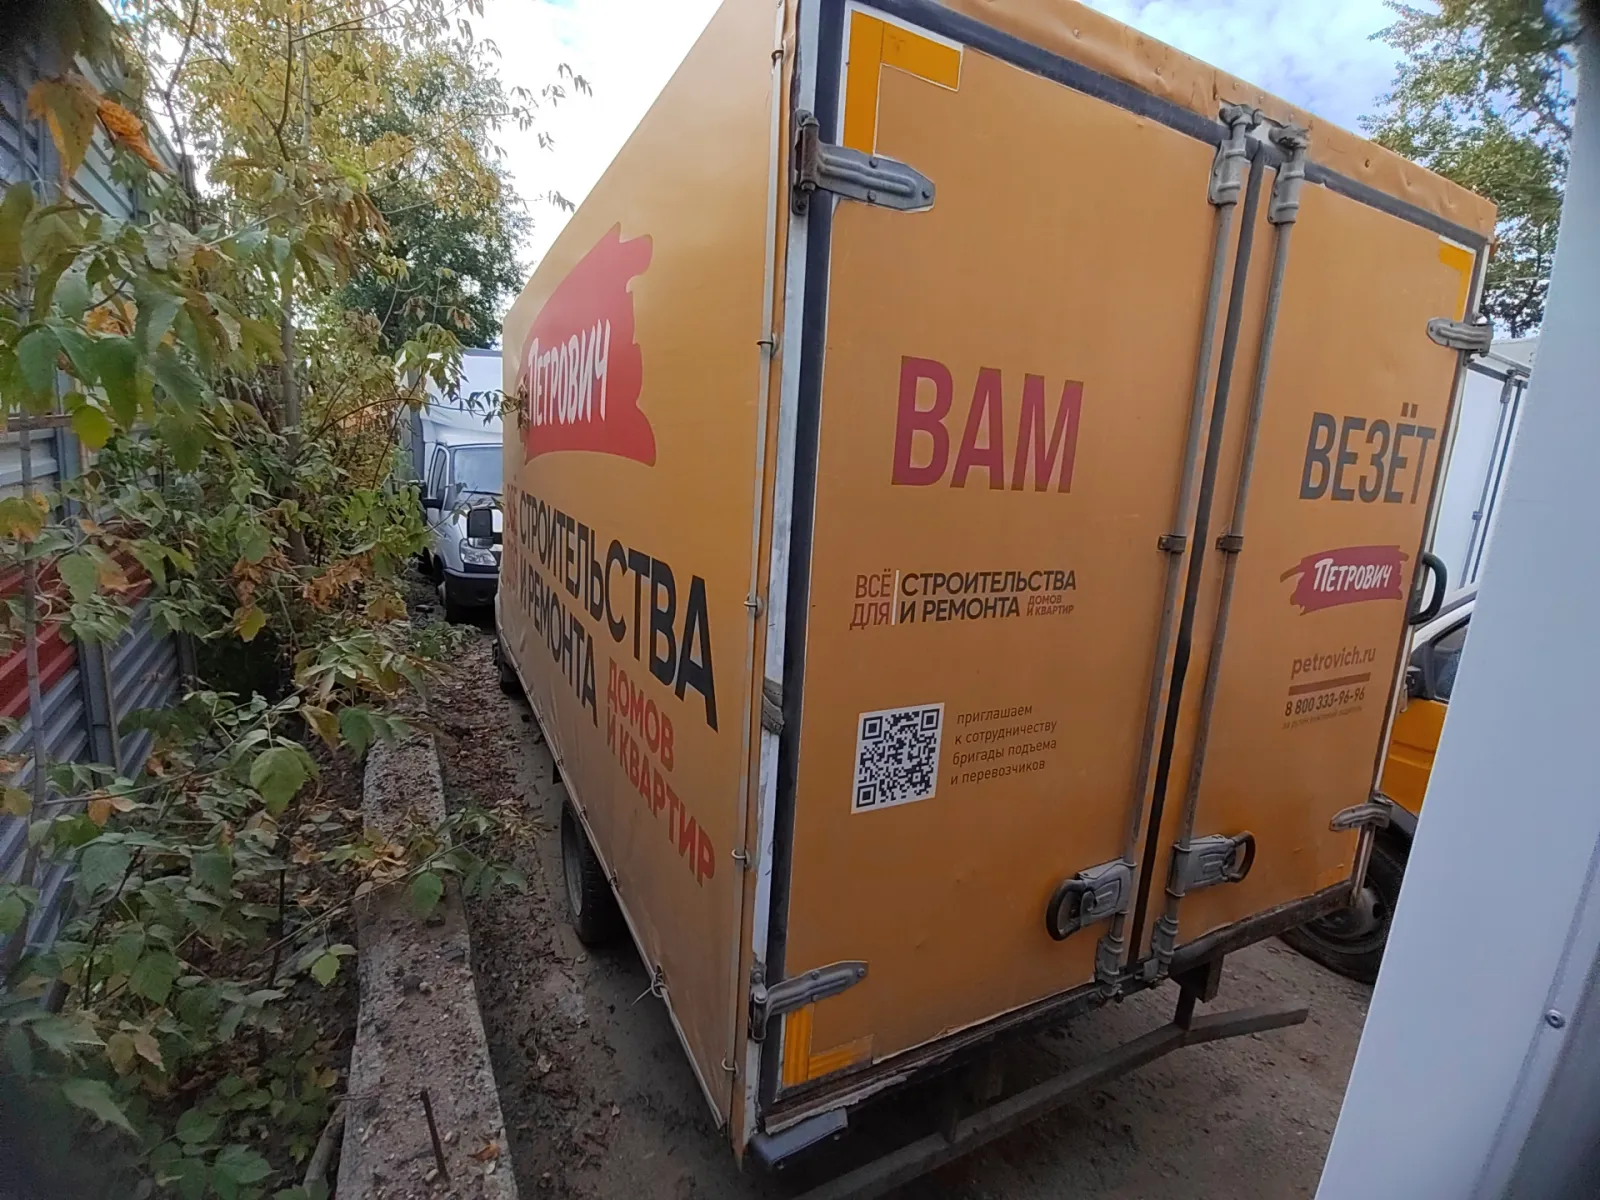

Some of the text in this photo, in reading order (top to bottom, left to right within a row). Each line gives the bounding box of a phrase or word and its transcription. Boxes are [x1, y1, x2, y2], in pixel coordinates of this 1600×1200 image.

[528, 319, 610, 426] ПЕТРОВИЧ
[891, 355, 1084, 493] ВАМ
[1299, 402, 1436, 504] ВЕЗЁТ
[855, 568, 891, 599] ВСЁ
[901, 570, 1076, 597] СТРОИТЕЛЬСТВА
[1313, 558, 1392, 592] ПЕТРОВИЧ
[520, 490, 718, 733] СТРОИТЕЛЬСТВА
[899, 596, 1020, 624] И РЕМОНТА
[1028, 594, 1062, 606] ДОМОВ
[1035, 604, 1074, 616] КВАРТИР
[849, 602, 891, 630] ДЛЯ
[528, 564, 597, 728] РЕМОНТА
[1291, 646, 1376, 680] petrovich.ru
[607, 657, 674, 772] ДОМОВ
[956, 705, 1032, 727] приглашаем
[1285, 687, 1366, 717] 8 800 333-96-96
[954, 720, 1057, 745] к сотрудничеству
[952, 738, 1057, 767] бригады подъема
[950, 759, 1045, 785] и перевозчиков
[606, 707, 715, 888] И КВАРТИР
